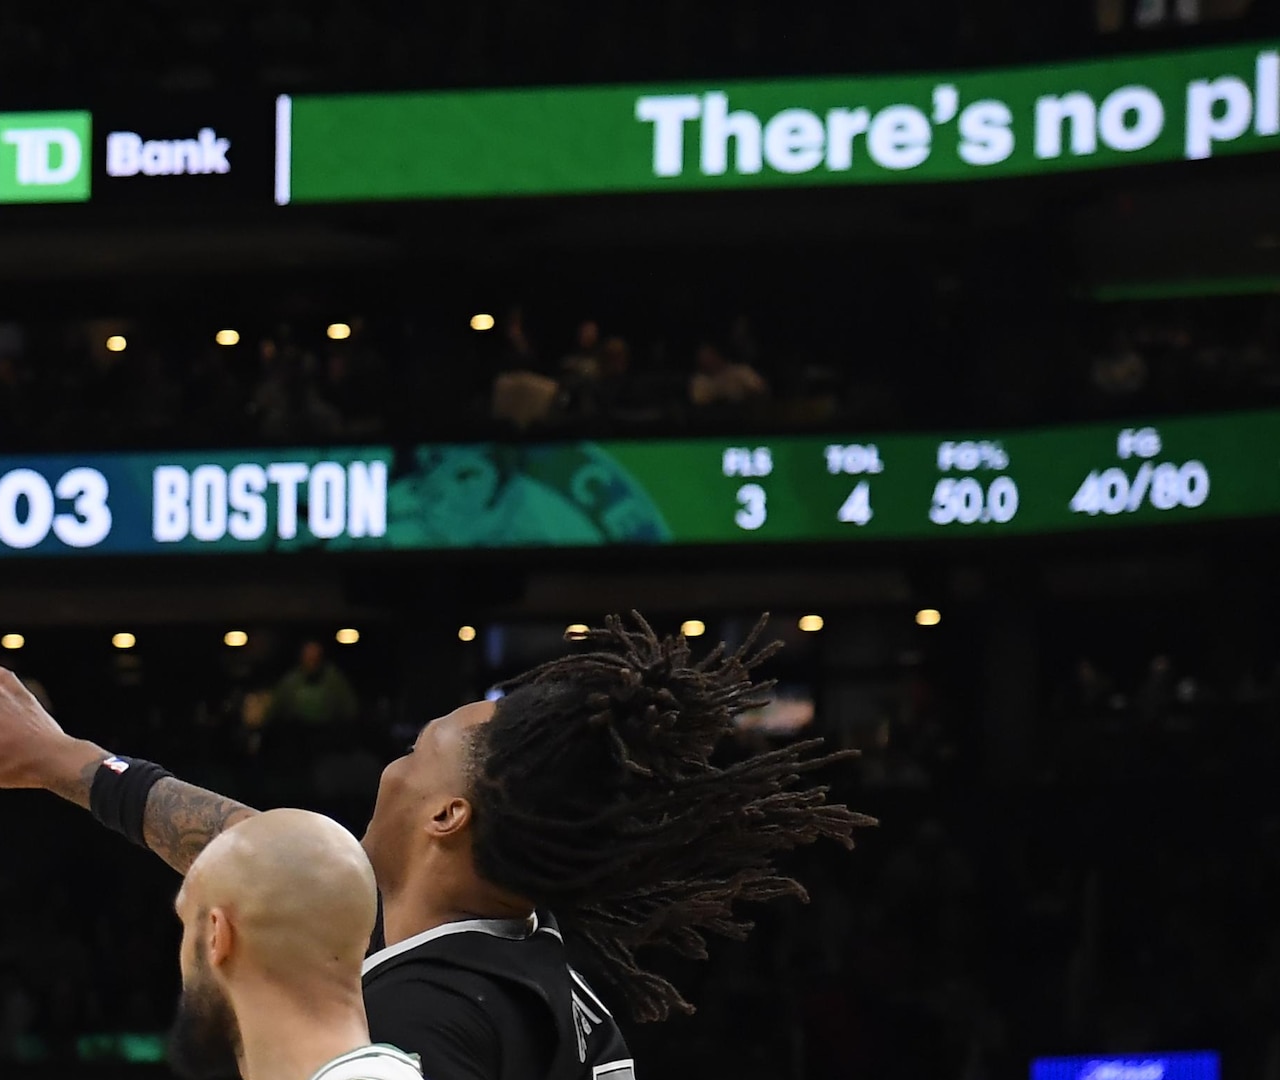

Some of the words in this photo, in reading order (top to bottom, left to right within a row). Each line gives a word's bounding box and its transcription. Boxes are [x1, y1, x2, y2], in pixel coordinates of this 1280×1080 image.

[635, 85, 1015, 177] There's
[1036, 88, 1164, 158] no
[1185, 50, 1280, 160] pl
[0, 127, 83, 187] TD
[106, 129, 229, 177] Bank
[722, 447, 773, 478] FLS
[938, 442, 1007, 471] FG%
[1118, 431, 1161, 458] FG
[153, 461, 387, 542] BOSTON
[736, 484, 767, 531] 3
[839, 484, 872, 526] 4
[930, 476, 1019, 525] 50.0
[1070, 461, 1210, 515] 40/80
